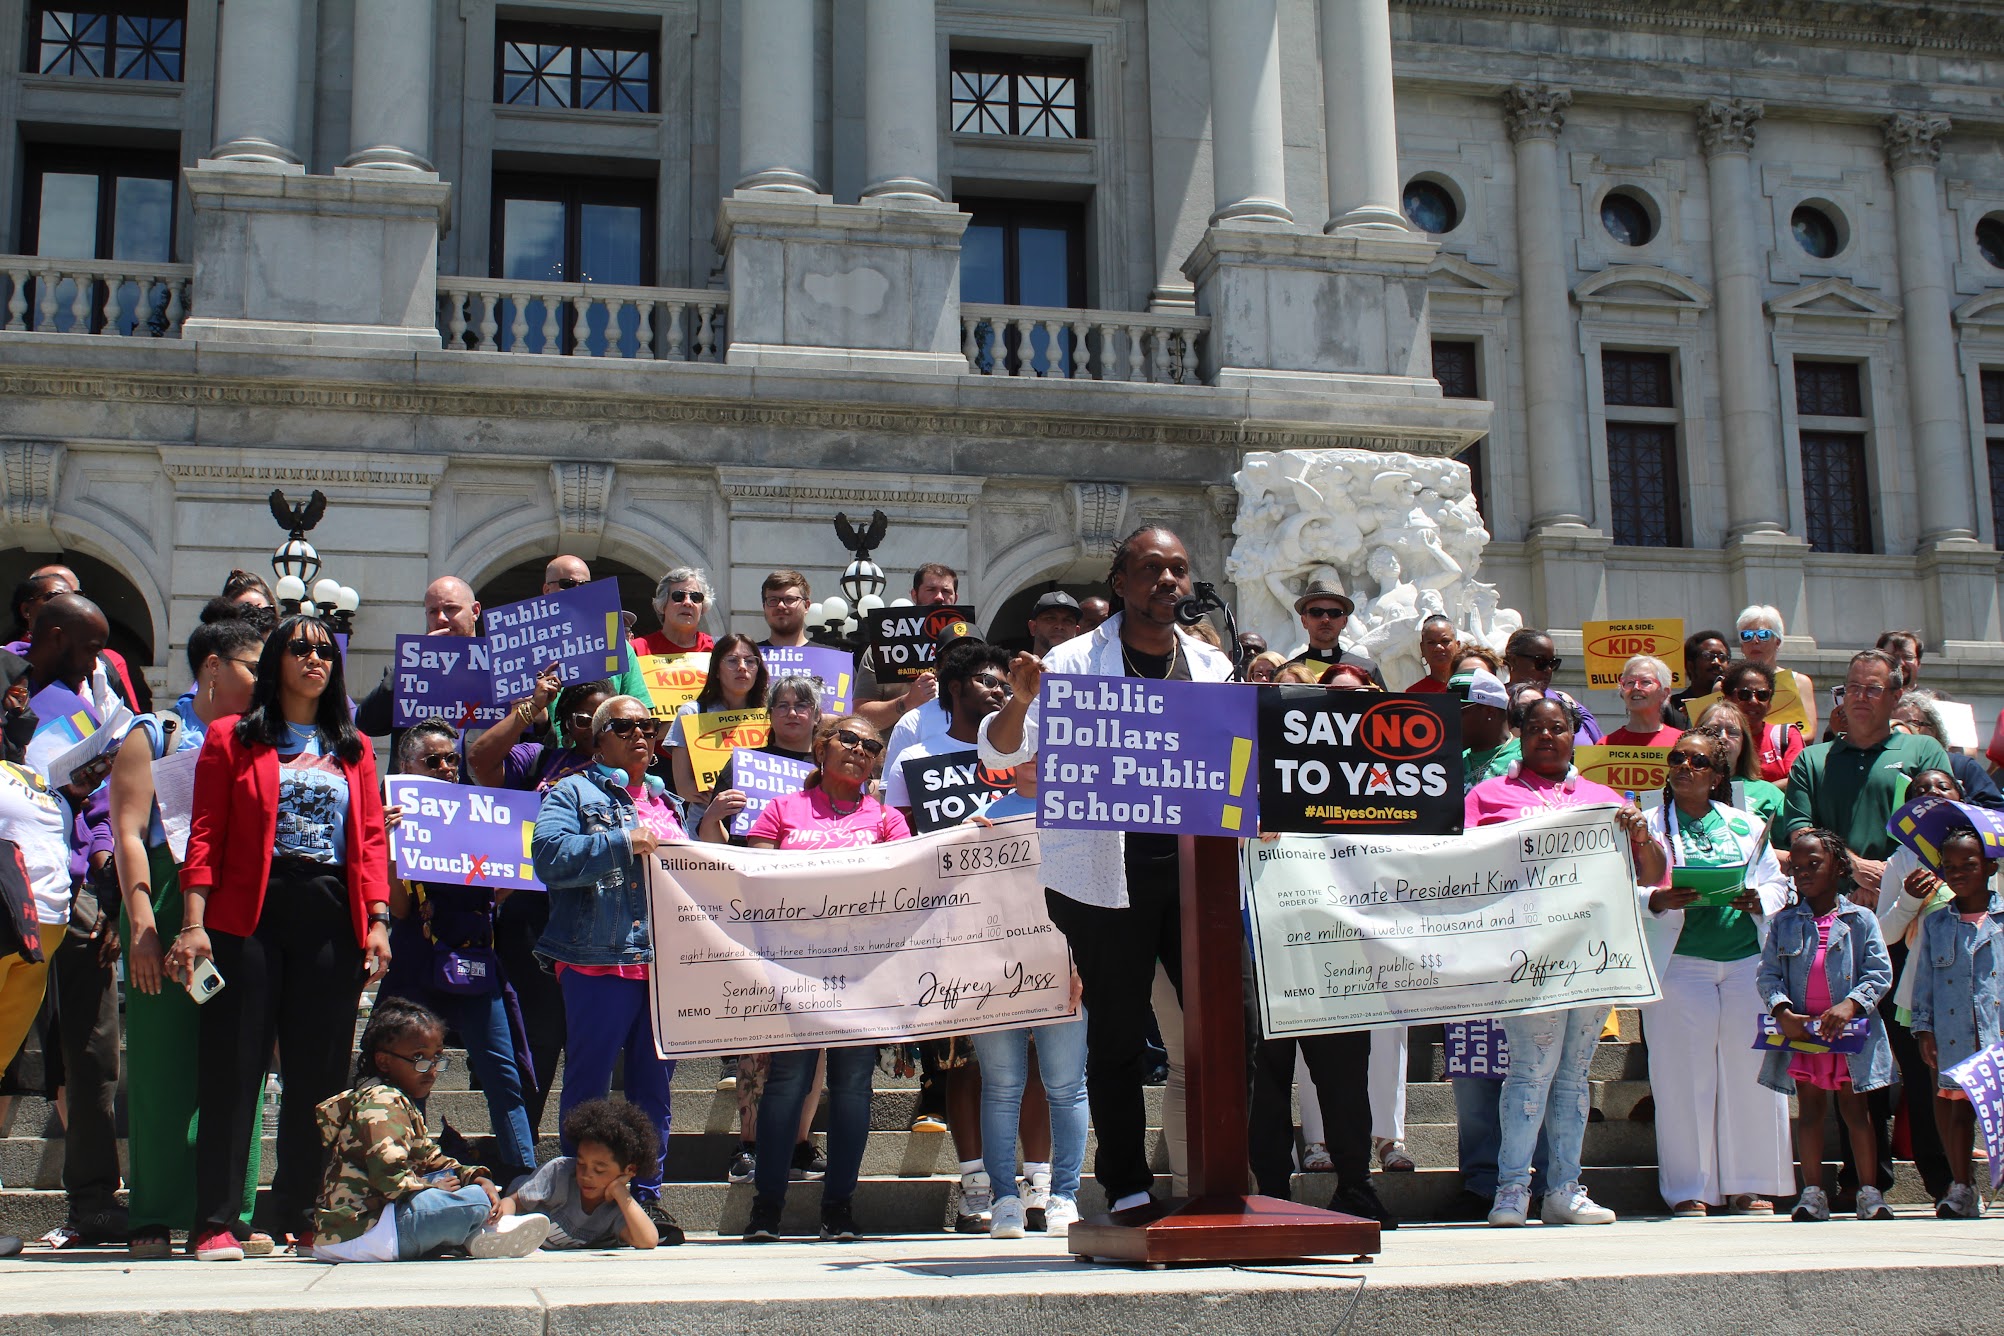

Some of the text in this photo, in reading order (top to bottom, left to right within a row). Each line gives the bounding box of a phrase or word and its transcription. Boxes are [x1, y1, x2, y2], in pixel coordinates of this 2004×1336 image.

[487, 600, 560, 631] Public
[882, 618, 925, 637] SAY
[489, 621, 572, 653] Dollars
[1609, 638, 1655, 654] KIDS
[402, 642, 460, 675] Say
[493, 635, 604, 676] for Public
[879, 646, 908, 664] TO
[400, 674, 429, 694] To
[495, 664, 580, 698] Schls
[656, 670, 708, 686] KIDS
[1046, 680, 1164, 714] Public
[719, 715, 740, 723] PICK
[1284, 710, 1436, 748] SAY NO
[1046, 716, 1180, 752] Dollars
[737, 751, 809, 781] Public
[922, 763, 978, 792] SAY
[1044, 754, 1225, 791] for Public
[1275, 759, 1448, 796] TO YASS
[1608, 767, 1664, 786] KIDS
[399, 787, 511, 825] Say No
[923, 796, 966, 823] TO
[1044, 790, 1181, 825] Schools
[1305, 805, 1418, 821] #AllEyesOnYass
[401, 820, 431, 843] To
[788, 830, 823, 844] ONE
[1524, 828, 1609, 856] $1,012,000
[661, 859, 735, 871] Billionaire
[943, 840, 1031, 871] $ 883,622
[1258, 849, 1326, 861] Billionaire
[1330, 845, 1356, 859] Jeff
[1360, 844, 1392, 856] Yass
[1327, 863, 1578, 905] Senate President Kim Ward
[678, 914, 707, 922] ORDER
[729, 887, 970, 921] Senator Jarrett Coleman
[1548, 910, 1591, 923] DOLLARS
[987, 915, 999, 925] 00
[1007, 924, 1052, 938] DOLLARS
[1287, 903, 1534, 943] one million, twelve thousand and 00
[680, 927, 1001, 966] eight hundred eighty-three thousand, six hundred twenty-two and 100
[1324, 954, 1442, 982] Sending public $$$
[1510, 940, 1632, 987] Jeffrey Yass
[722, 974, 847, 1002] Sending public $$$
[918, 961, 1056, 1010] Jeffrey Yass
[1284, 988, 1315, 998] MEMO
[1326, 971, 1439, 1000] to private schools
[678, 1007, 711, 1017] MEMO
[724, 993, 842, 1021] to private schools
[954, 1017, 969, 1025] given
[1492, 1040, 1508, 1074] for
